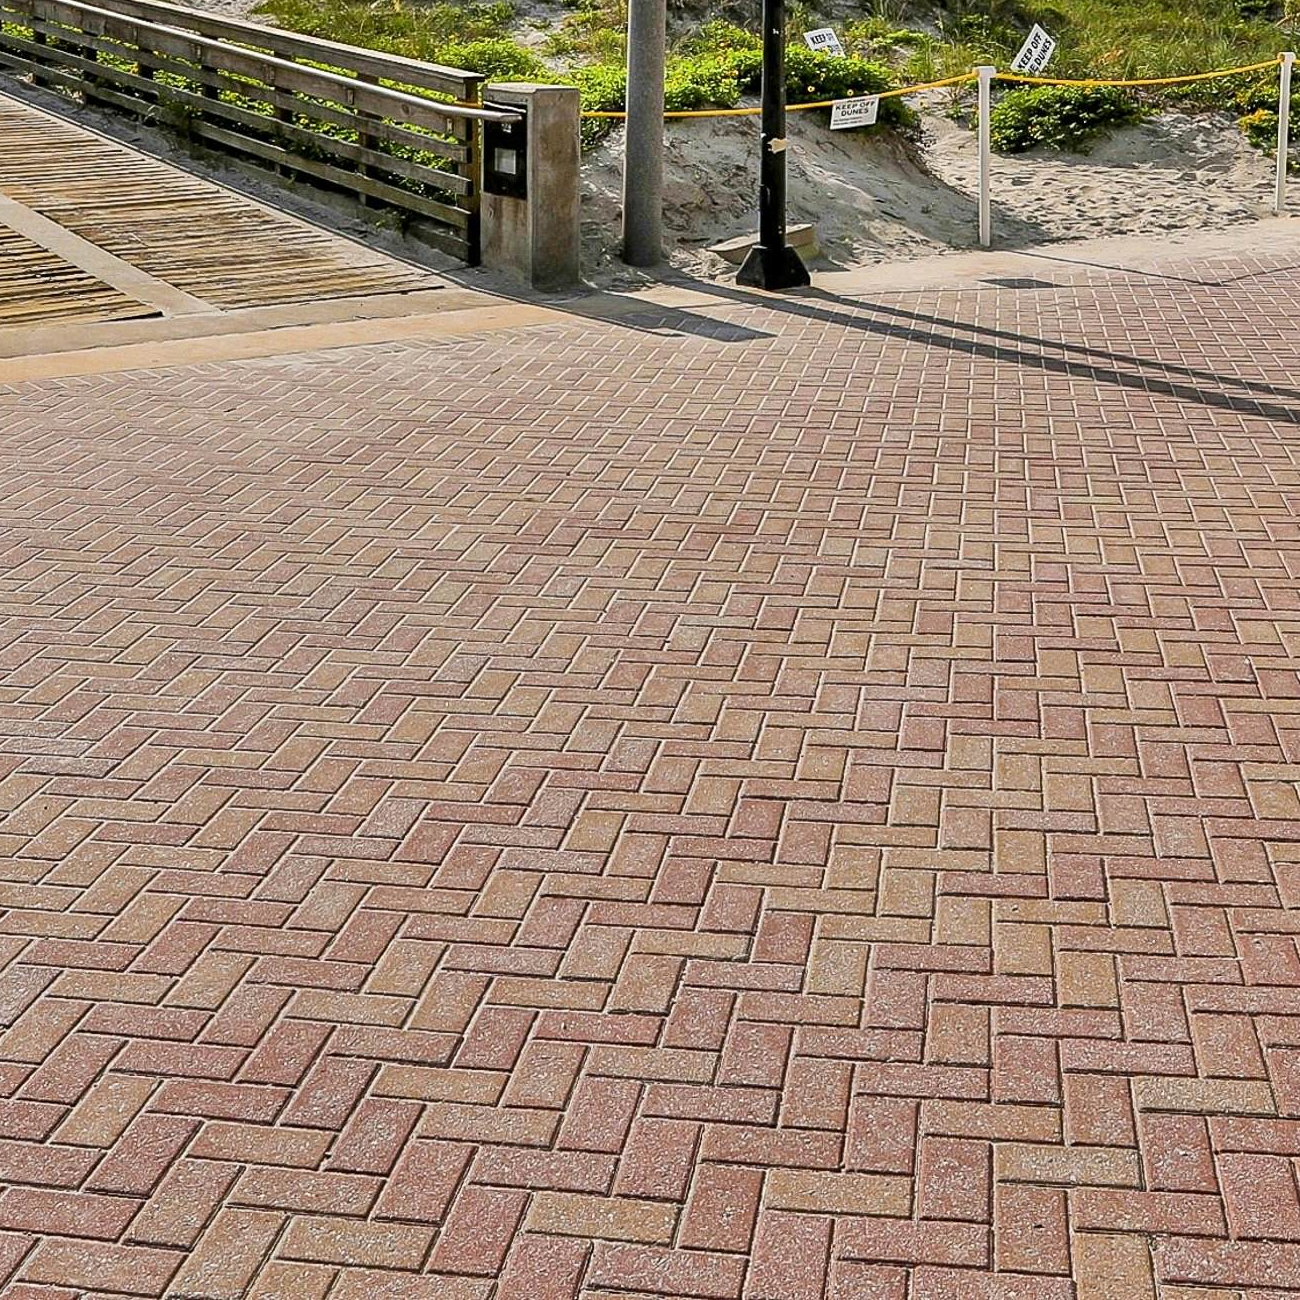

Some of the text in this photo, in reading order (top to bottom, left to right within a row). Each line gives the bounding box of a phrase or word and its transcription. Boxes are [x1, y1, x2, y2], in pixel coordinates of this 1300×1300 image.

[810, 33, 826, 45] KEEP
[1017, 32, 1042, 69] KEEP OFF
[1033, 38, 1052, 66] DUNES
[835, 103, 858, 111] KEEP
[859, 100, 875, 108] OFF
[841, 108, 869, 117] DUNES
